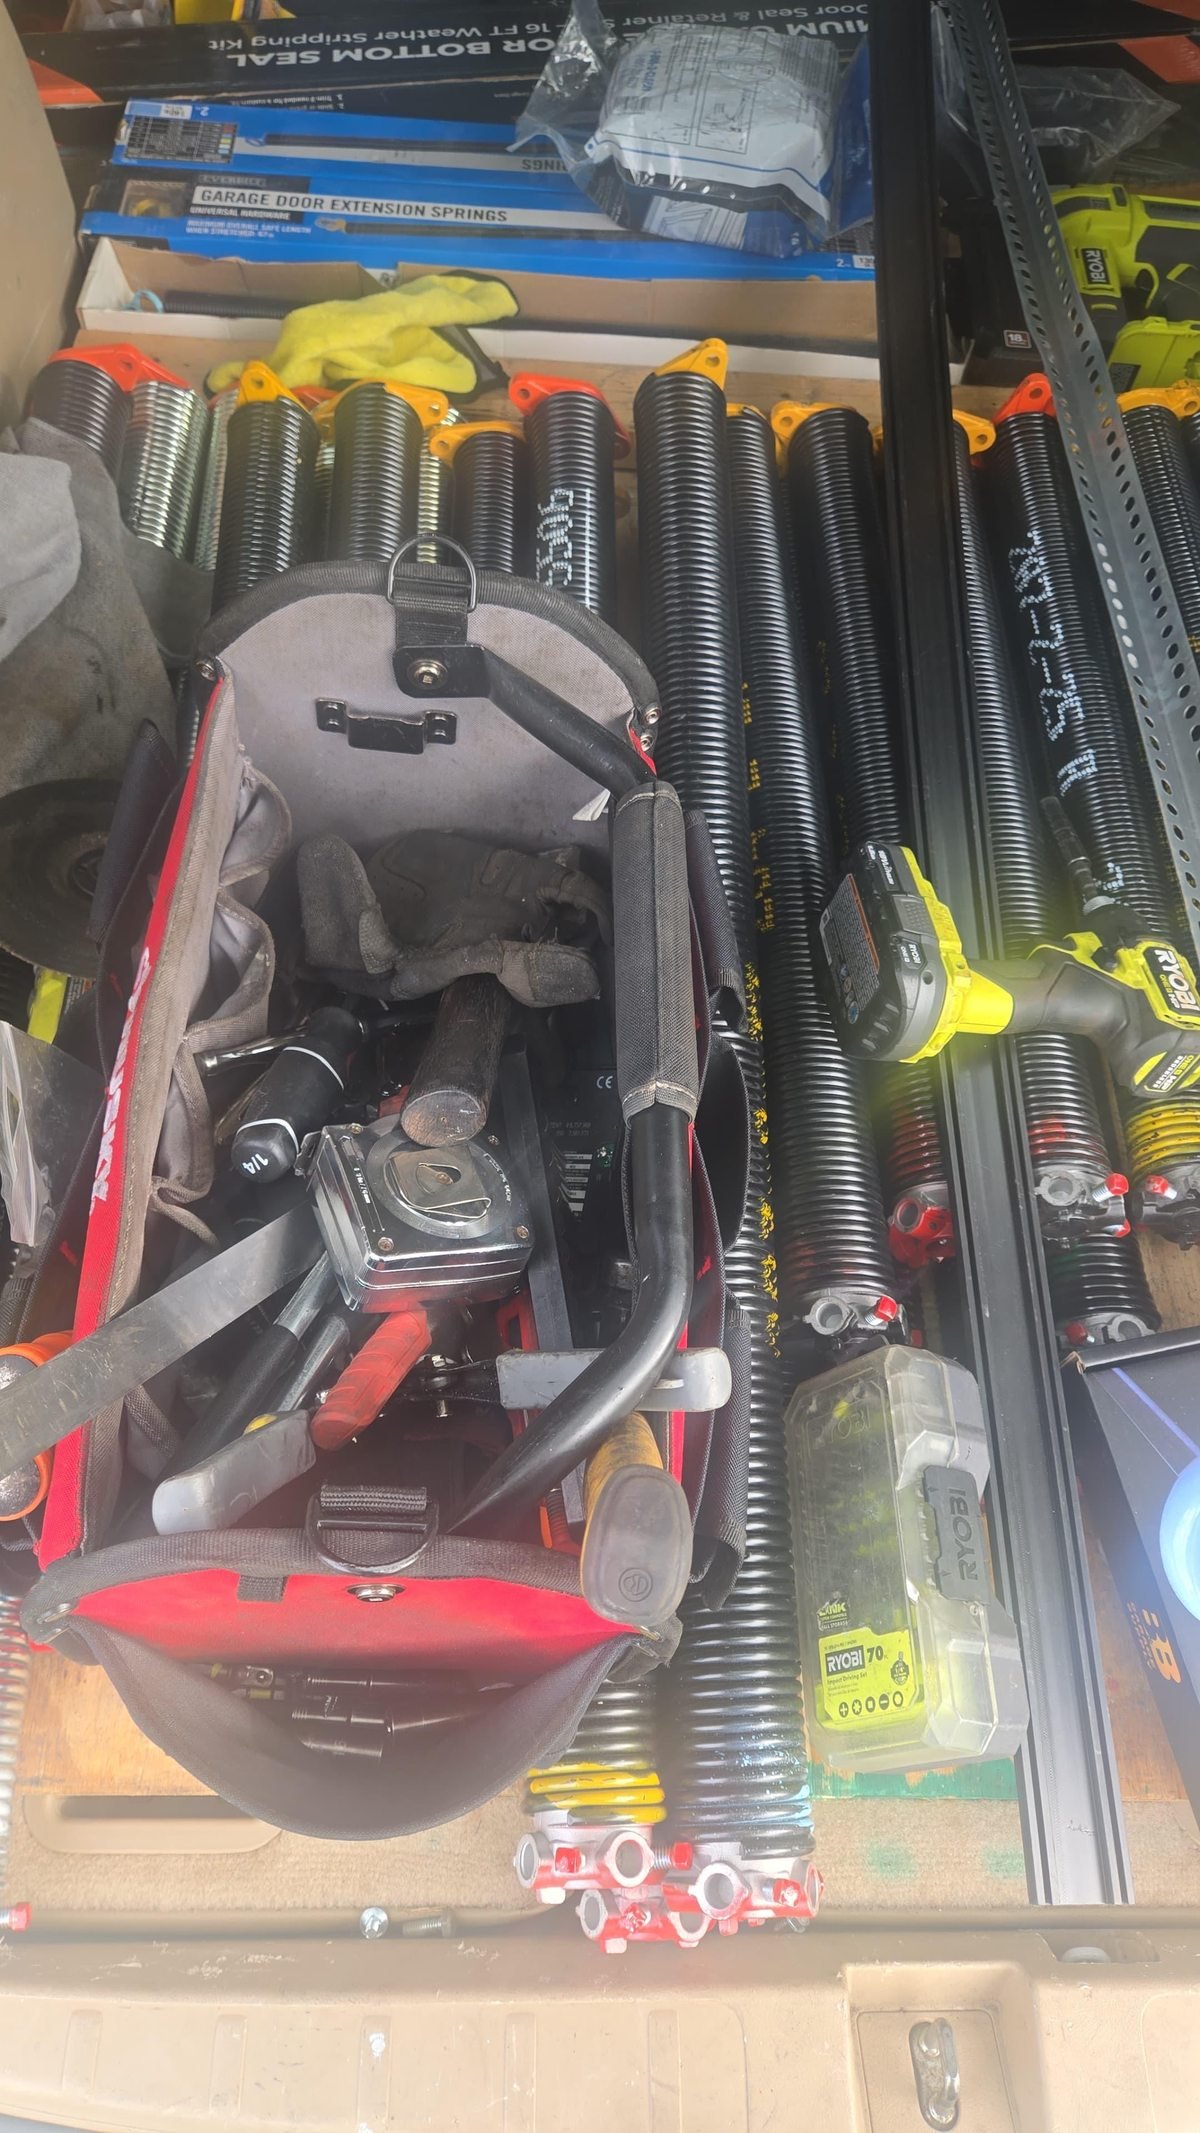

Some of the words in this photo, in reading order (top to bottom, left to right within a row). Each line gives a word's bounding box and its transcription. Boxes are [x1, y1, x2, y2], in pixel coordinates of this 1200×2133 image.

[622, 12, 727, 28] Retainer
[758, 7, 809, 20] Seal
[374, 26, 483, 43] Weather
[488, 25, 518, 37] FT
[526, 23, 551, 34] 16
[208, 38, 242, 52] Kit
[251, 31, 368, 50] Stripping
[226, 49, 321, 68] SEAL
[331, 40, 491, 63] BOTTOM
[190, 206, 238, 217] UNIVERSAL
[241, 208, 291, 220] HARDWARE
[201, 189, 270, 206] GARAGE
[276, 196, 324, 210] DOOR
[330, 198, 426, 216] EXTENSION
[431, 205, 508, 223] SPRINGS
[1085, 249, 1107, 284] RYOBI
[1155, 949, 1200, 1012] RYOBI
[596, 1075, 613, 1089] CE
[242, 1153, 269, 1175] 1/4
[949, 1487, 979, 1582] RYOBI
[827, 1649, 863, 1673] RYOBI
[866, 1645, 884, 1663] 70
[843, 1674, 860, 1683] Driving
